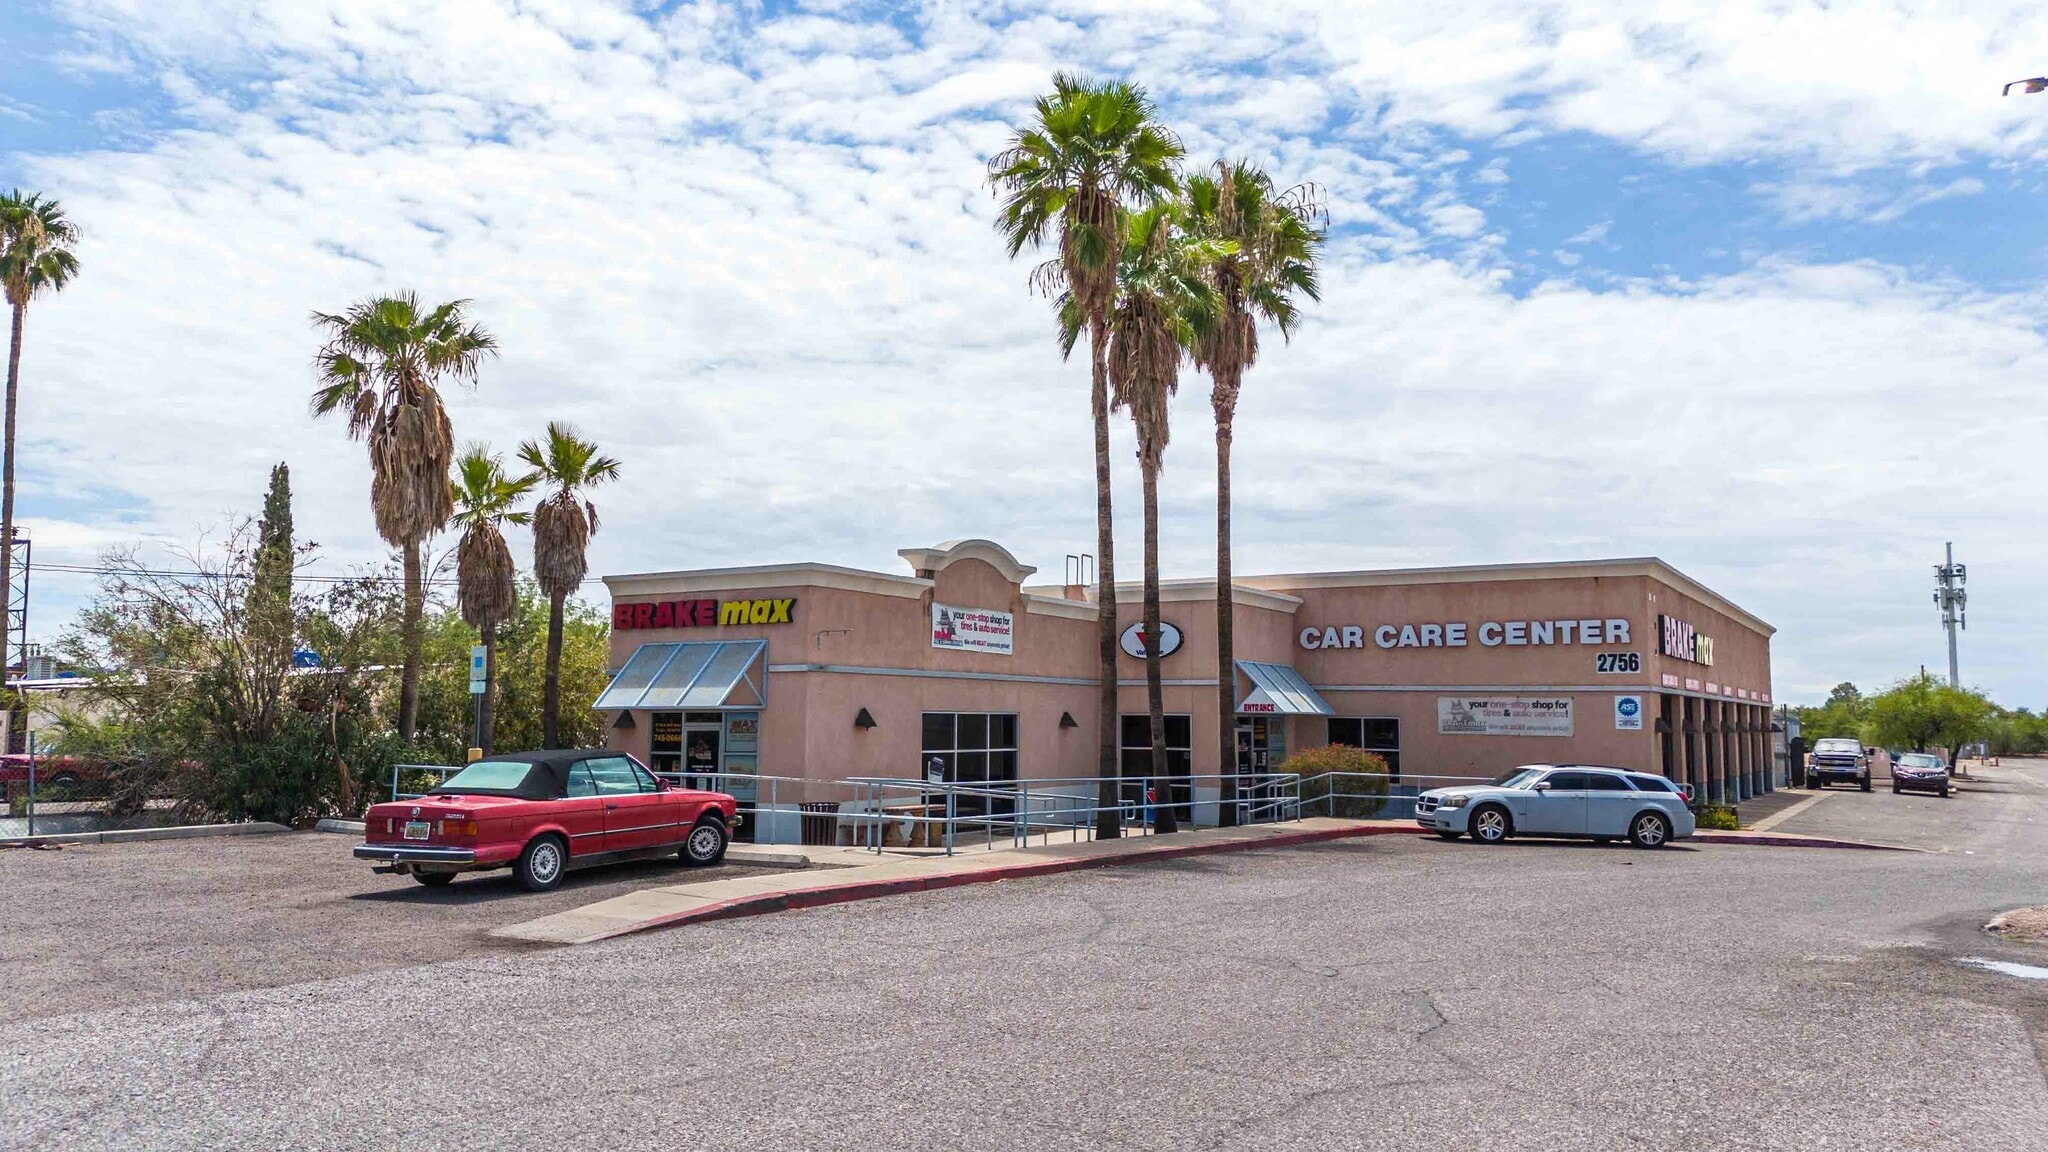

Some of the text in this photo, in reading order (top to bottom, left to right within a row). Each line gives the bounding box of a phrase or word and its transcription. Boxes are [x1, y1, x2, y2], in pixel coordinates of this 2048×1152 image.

[614, 598, 792, 629] BRAKE max
[953, 611, 1010, 626] your one-stop shop for
[973, 622, 978, 631] &
[1300, 618, 1631, 649] CAR CARE CENTER
[1663, 614, 1714, 667] BRAKE max
[1597, 653, 1639, 672] 2756
[1243, 703, 1275, 712] ENTRANCE
[1469, 700, 1568, 710] your one-stop shop for
[1503, 709, 1511, 717] &
